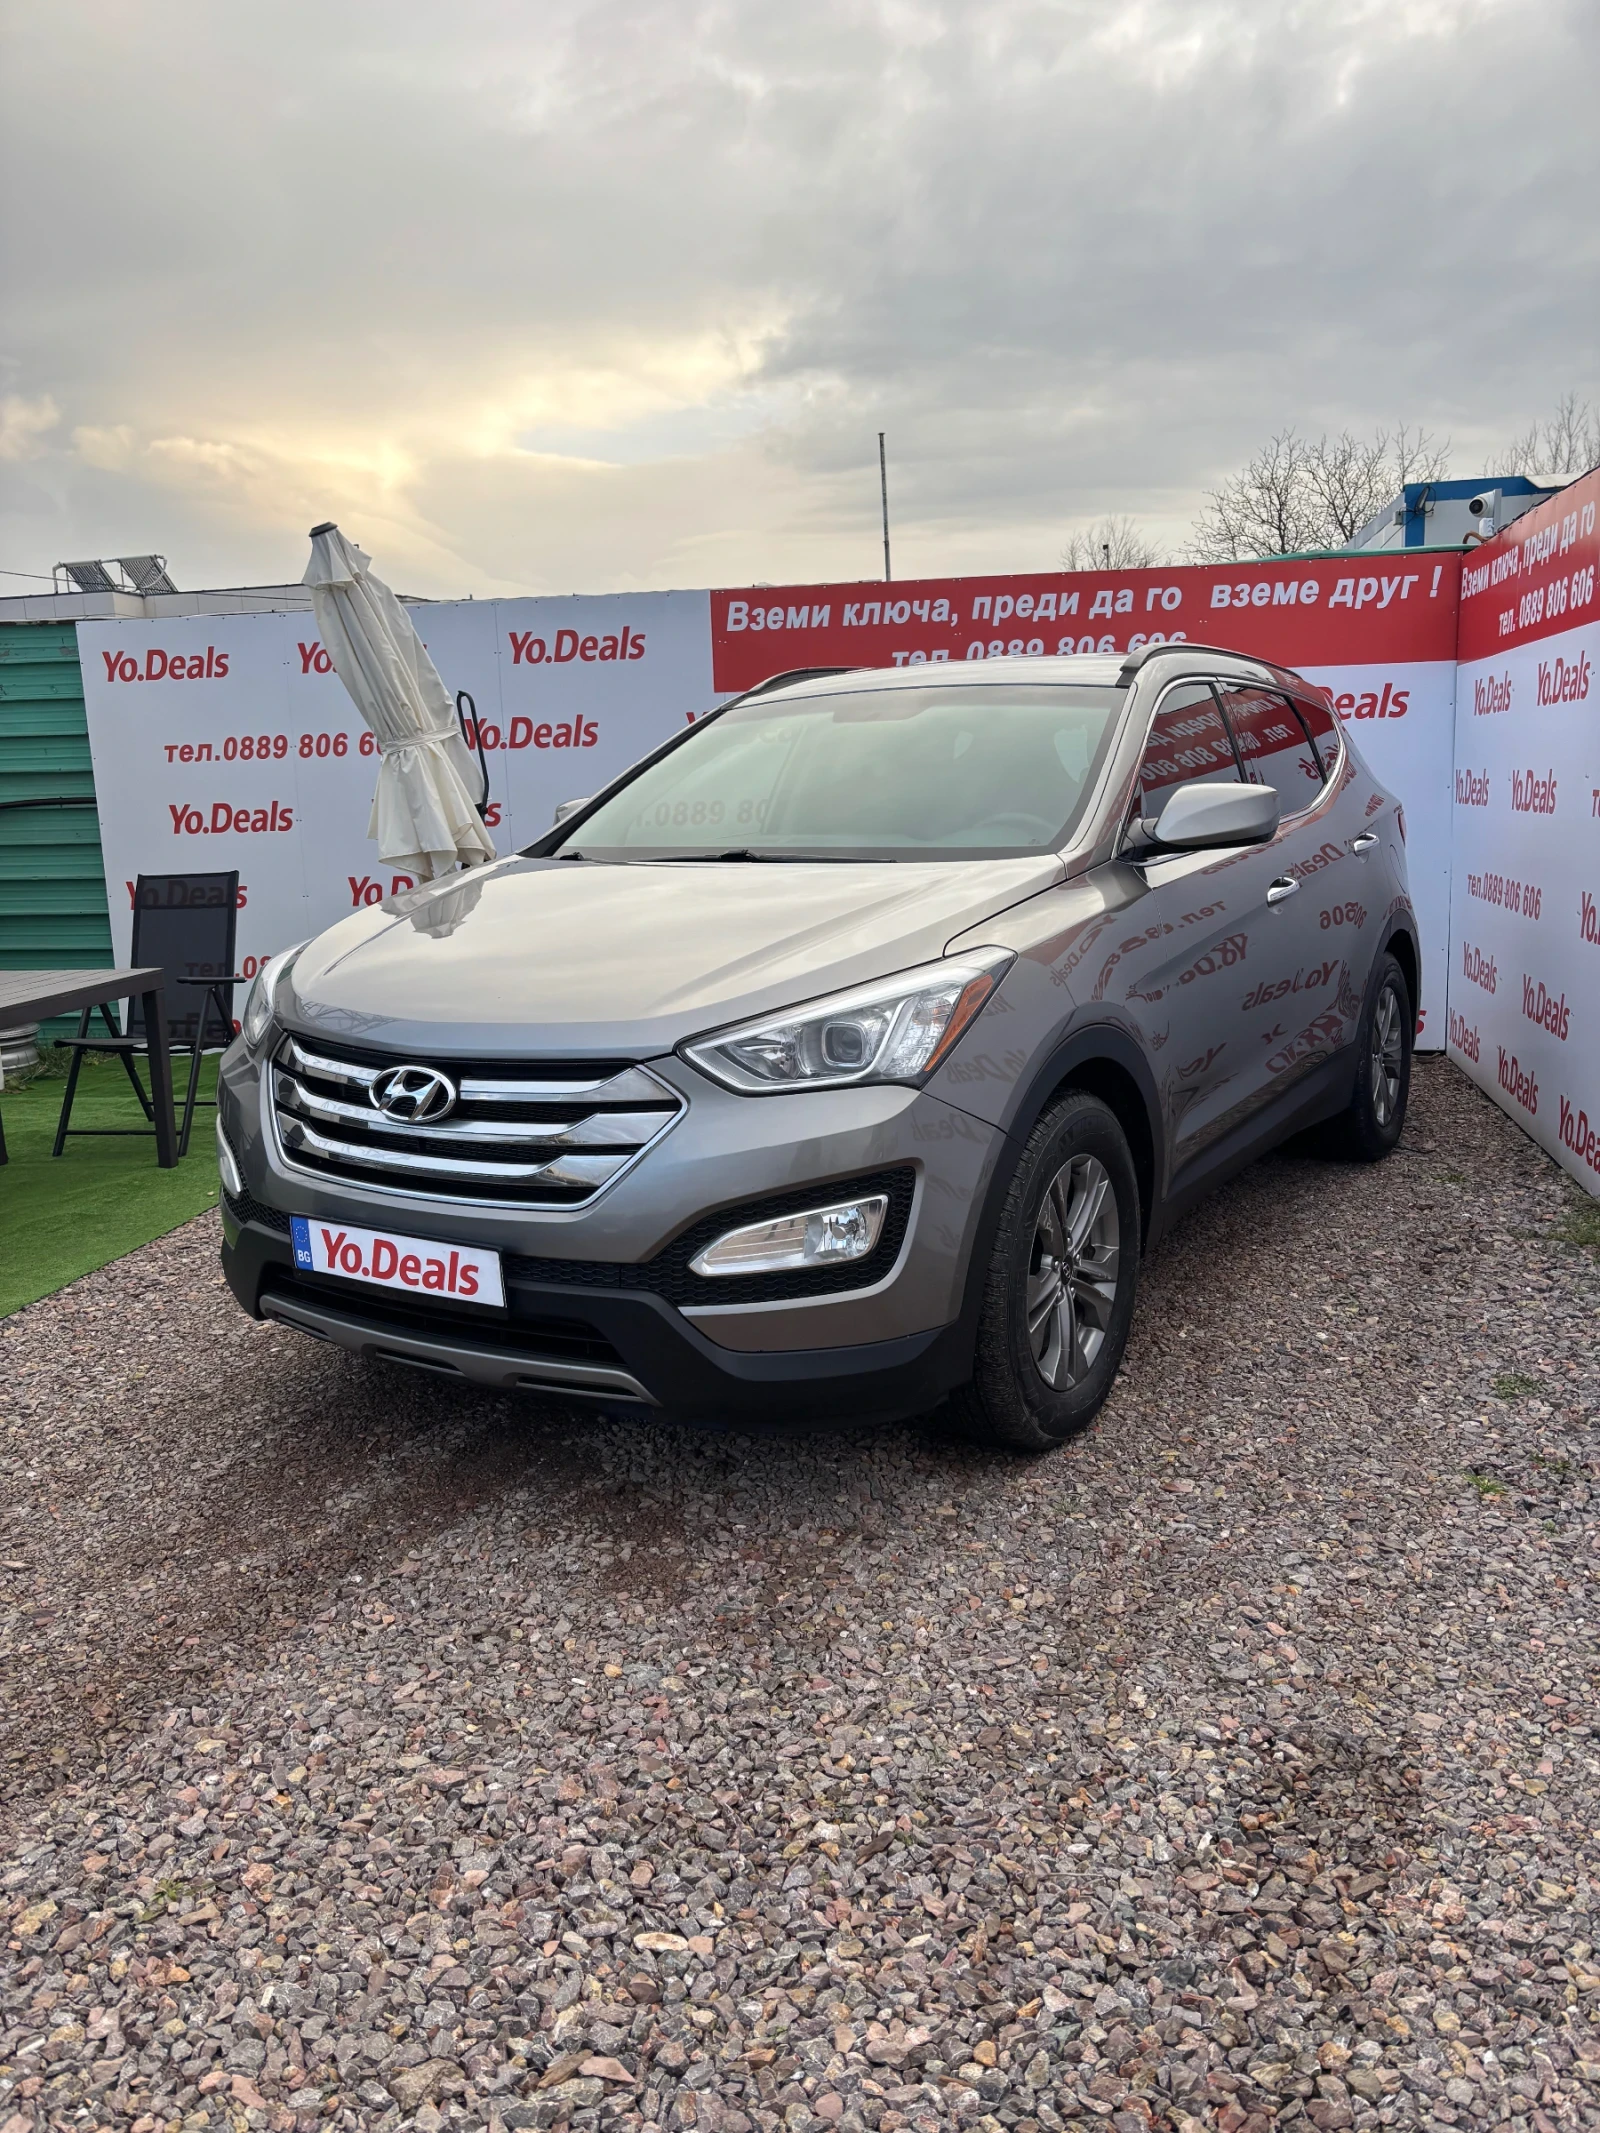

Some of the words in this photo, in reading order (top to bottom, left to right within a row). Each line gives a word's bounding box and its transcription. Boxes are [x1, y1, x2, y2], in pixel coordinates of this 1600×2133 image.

[1460, 562, 1490, 601] Вземи
[1490, 545, 1523, 579] ключа,
[1522, 522, 1558, 575] преди
[1559, 511, 1577, 557] да
[1580, 500, 1596, 540] го
[726, 601, 831, 632] Вземи
[842, 598, 958, 627] ключа,
[972, 591, 1080, 627] преди
[1088, 588, 1134, 620] да
[1146, 585, 1182, 613] го
[1210, 578, 1320, 609] вземе
[1328, 574, 1419, 609] друг
[1429, 565, 1443, 598] !
[1518, 587, 1545, 629] 0889
[1545, 576, 1568, 619] 806
[1570, 564, 1595, 610] 606
[102, 646, 229, 683] Yo.Deals
[508, 626, 646, 664] Yo.Deals
[1473, 670, 1512, 716] Yo.Deals
[1536, 649, 1591, 707] Yo.Deals
[164, 734, 288, 762] тел.0889
[298, 733, 348, 758] 806
[1455, 768, 1490, 806] Yo.Deals
[1511, 768, 1557, 814] Yo.Deals
[168, 800, 293, 834] Yo.Deals
[1467, 871, 1504, 906] тел.0889
[1504, 878, 1521, 913] 806
[1522, 884, 1542, 921] 606
[1463, 940, 1498, 995] Yo.Deals
[1522, 973, 1570, 1042] Yo.Deals
[1449, 1006, 1481, 1063] Yo.Deals
[1497, 1044, 1539, 1116] Yo.Deals
[297, 1249, 311, 1263] BG
[320, 1228, 480, 1296] Yo.Deals
